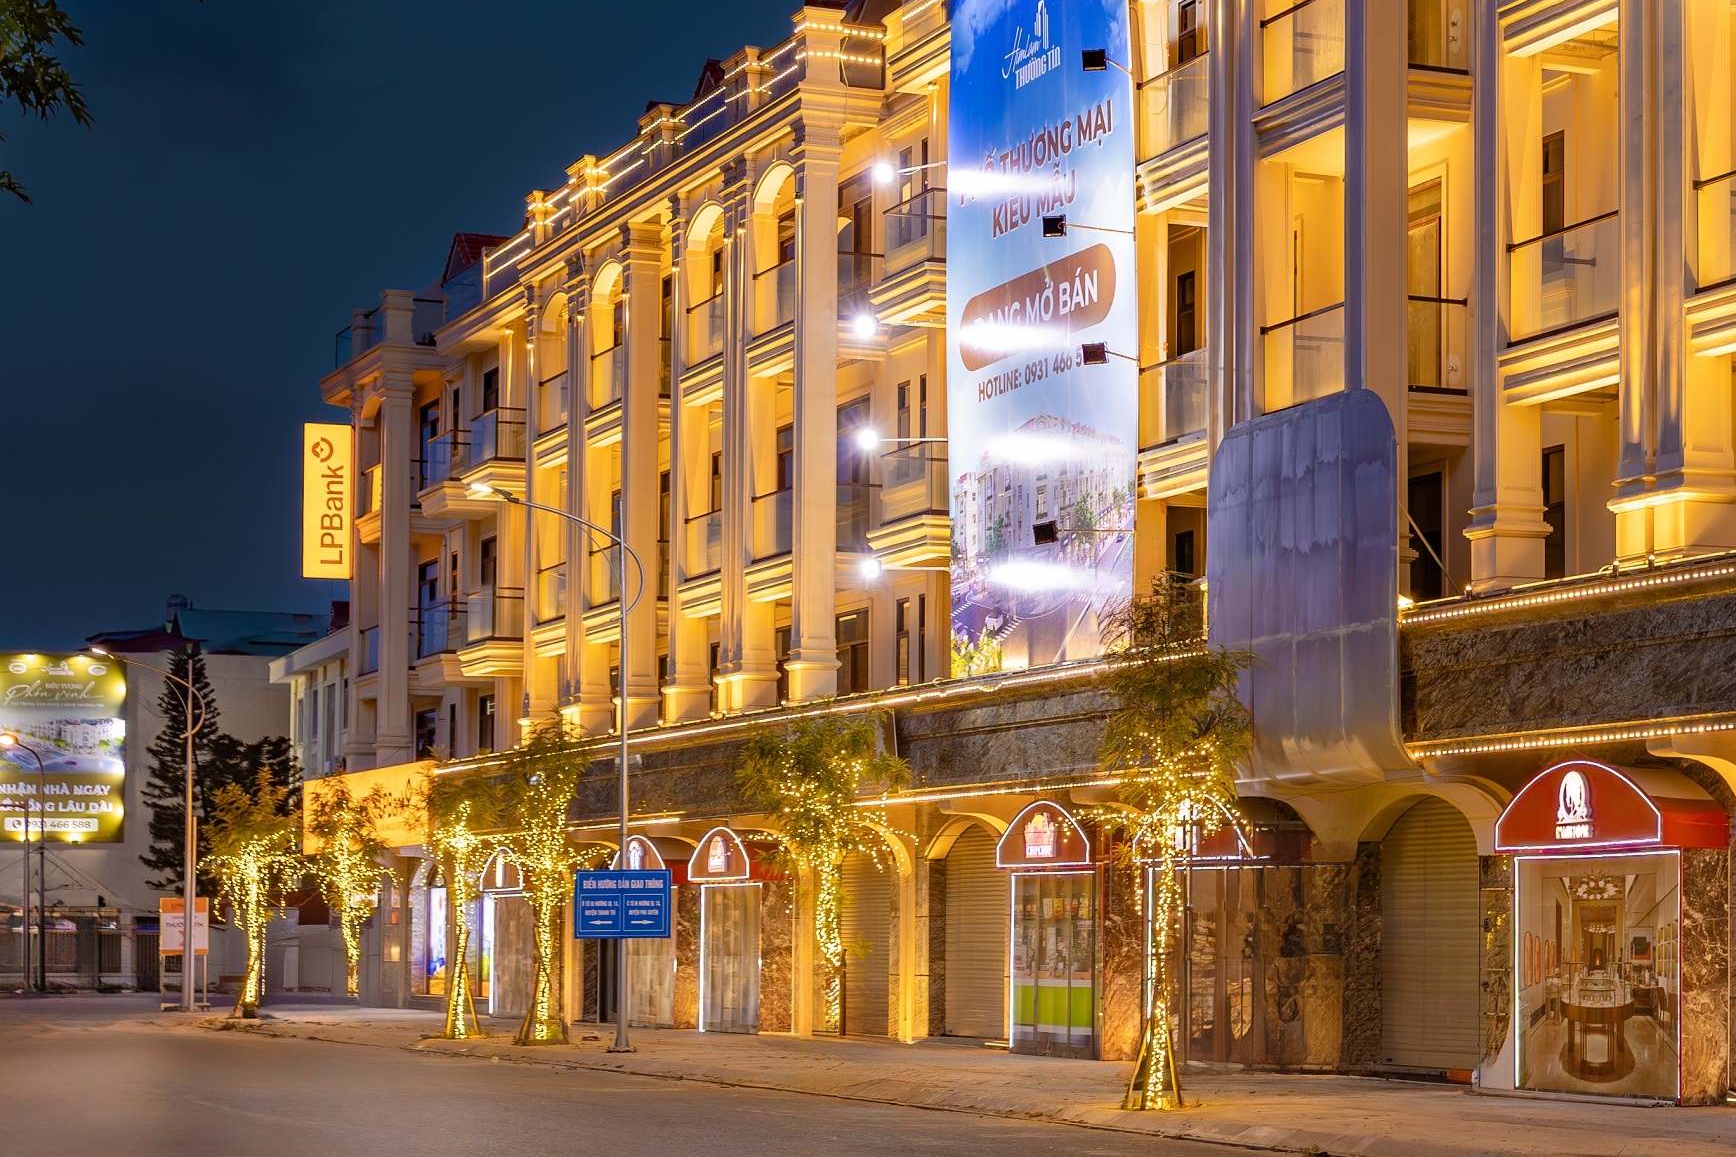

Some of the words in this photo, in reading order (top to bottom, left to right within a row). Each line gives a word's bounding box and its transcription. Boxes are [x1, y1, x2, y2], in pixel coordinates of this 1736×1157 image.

[1077, 99, 1113, 147] MẠI
[1059, 267, 1098, 316] BÁN
[978, 368, 1022, 403] HOTLINE:
[1024, 357, 1049, 386] 0931
[1053, 351, 1073, 375] 466
[320, 465, 344, 565] LPBank
[58, 799, 86, 812] LÂU
[73, 785, 111, 795] NGAY
[27, 820, 47, 829] 931
[50, 820, 70, 829] 466
[72, 820, 91, 829] 588
